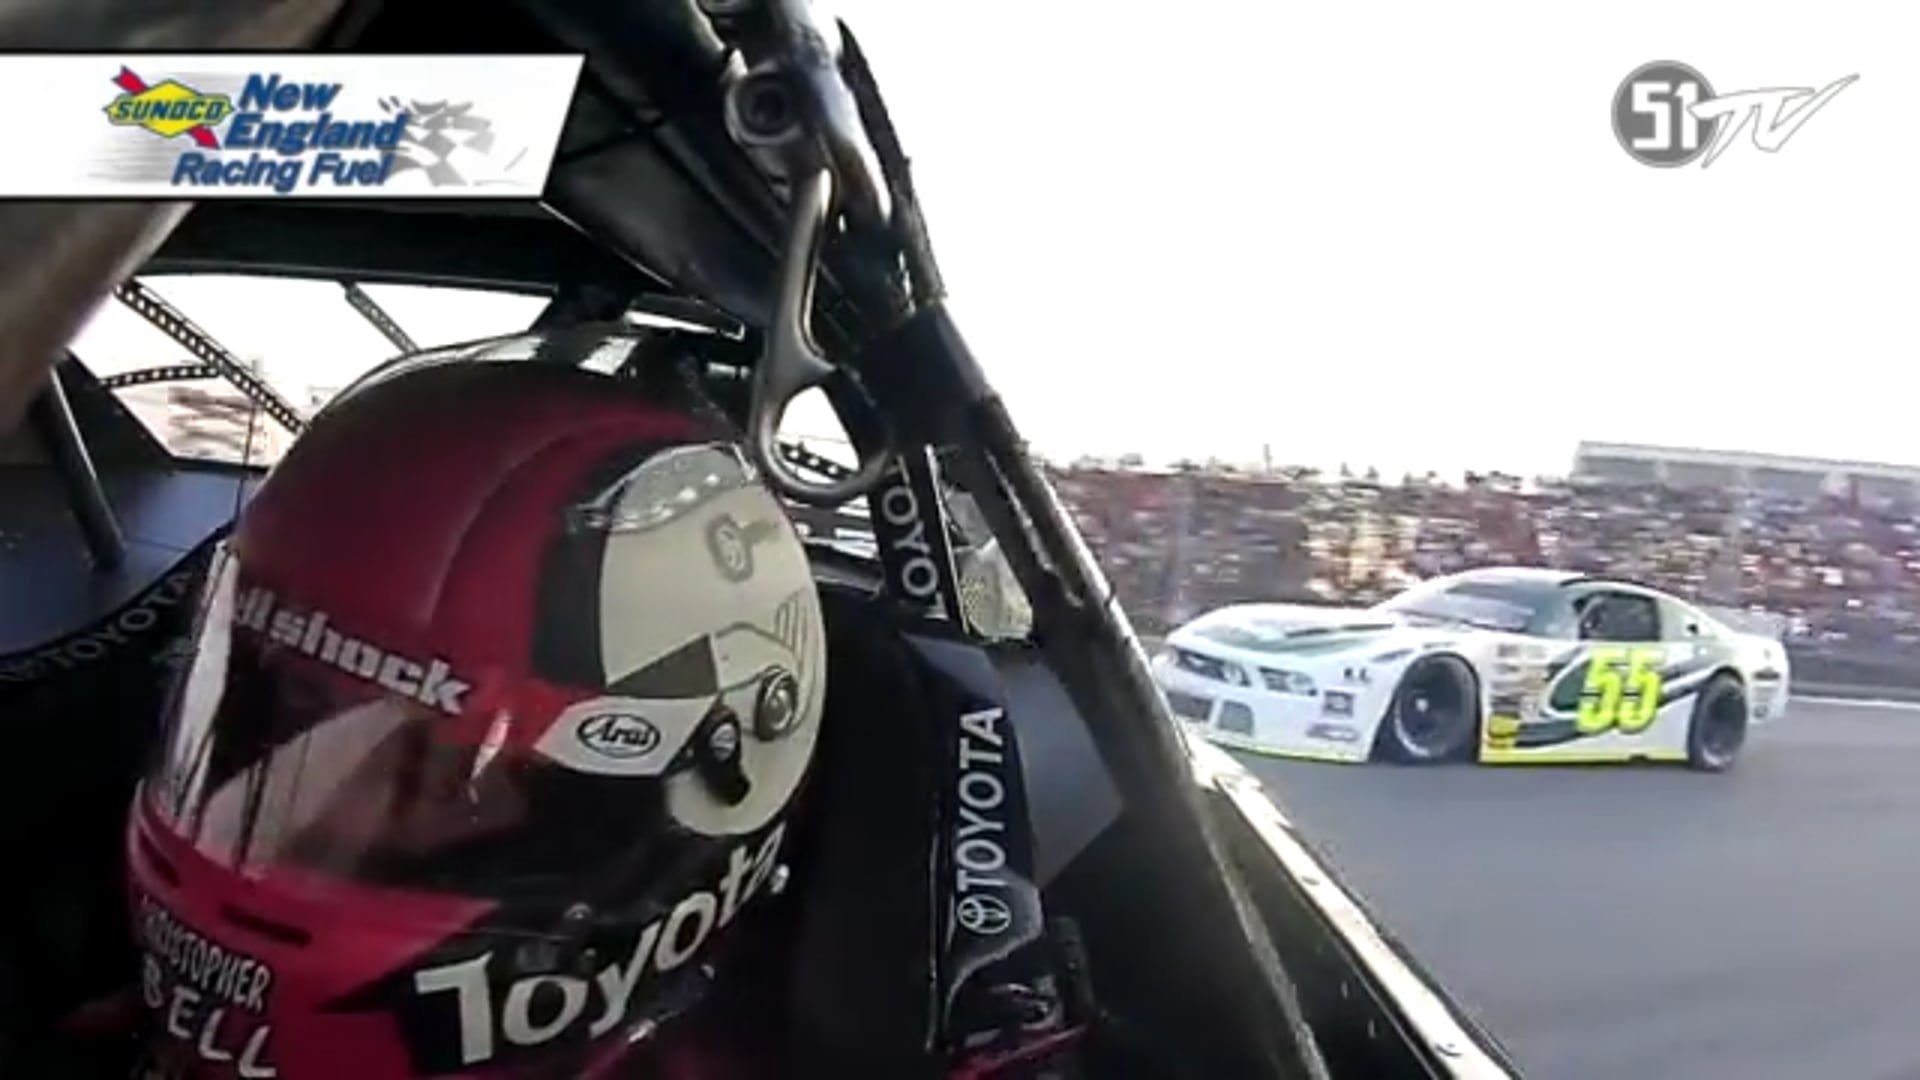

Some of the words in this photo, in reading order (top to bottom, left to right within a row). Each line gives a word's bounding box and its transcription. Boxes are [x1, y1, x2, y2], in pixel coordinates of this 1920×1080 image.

[582, 716, 650, 746] Arai
[1576, 646, 1663, 734] 55
[957, 706, 1006, 892] TOYOTA
[414, 822, 787, 1064] Toyota
[143, 952, 277, 1079] BELL
